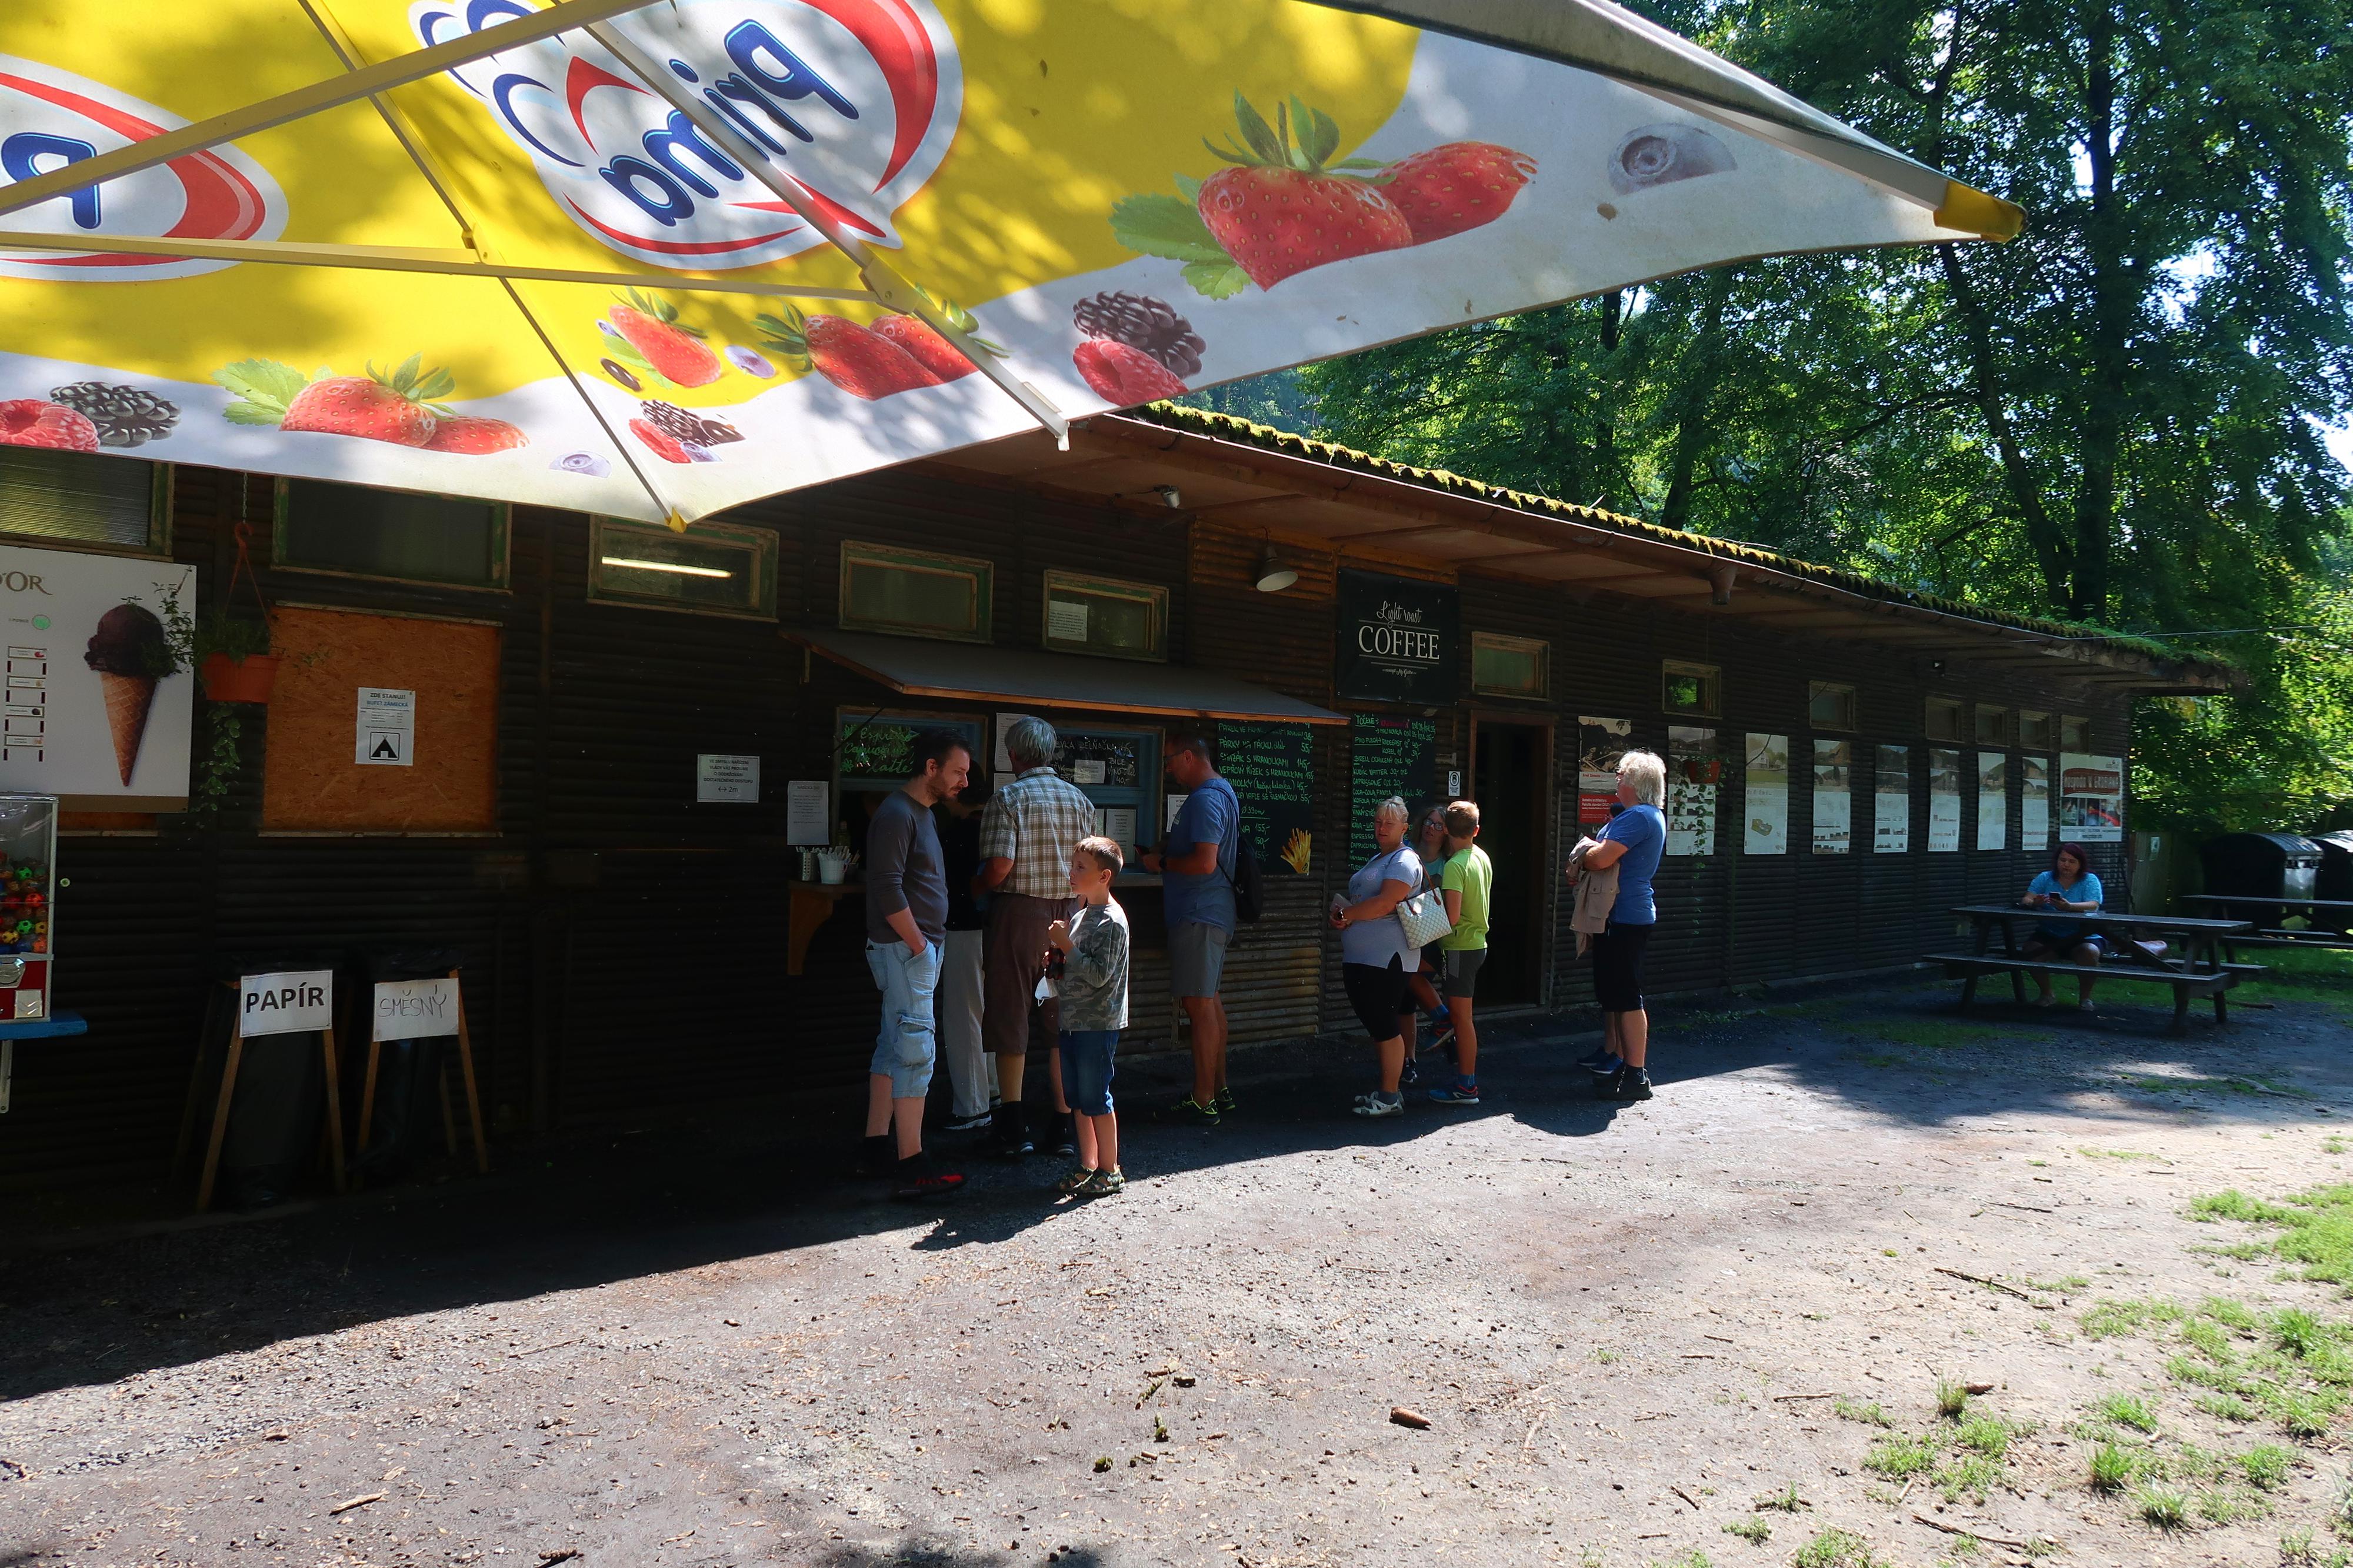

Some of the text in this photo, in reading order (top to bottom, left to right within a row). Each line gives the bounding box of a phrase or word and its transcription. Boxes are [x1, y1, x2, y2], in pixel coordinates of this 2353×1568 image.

[1377, 600, 1422, 629] Light roast
[1358, 625, 1439, 660] COFFEE
[1247, 755, 1252, 763] S
[246, 983, 325, 1013] PAPÍR
[379, 984, 447, 1018] SMĚSNÝ
